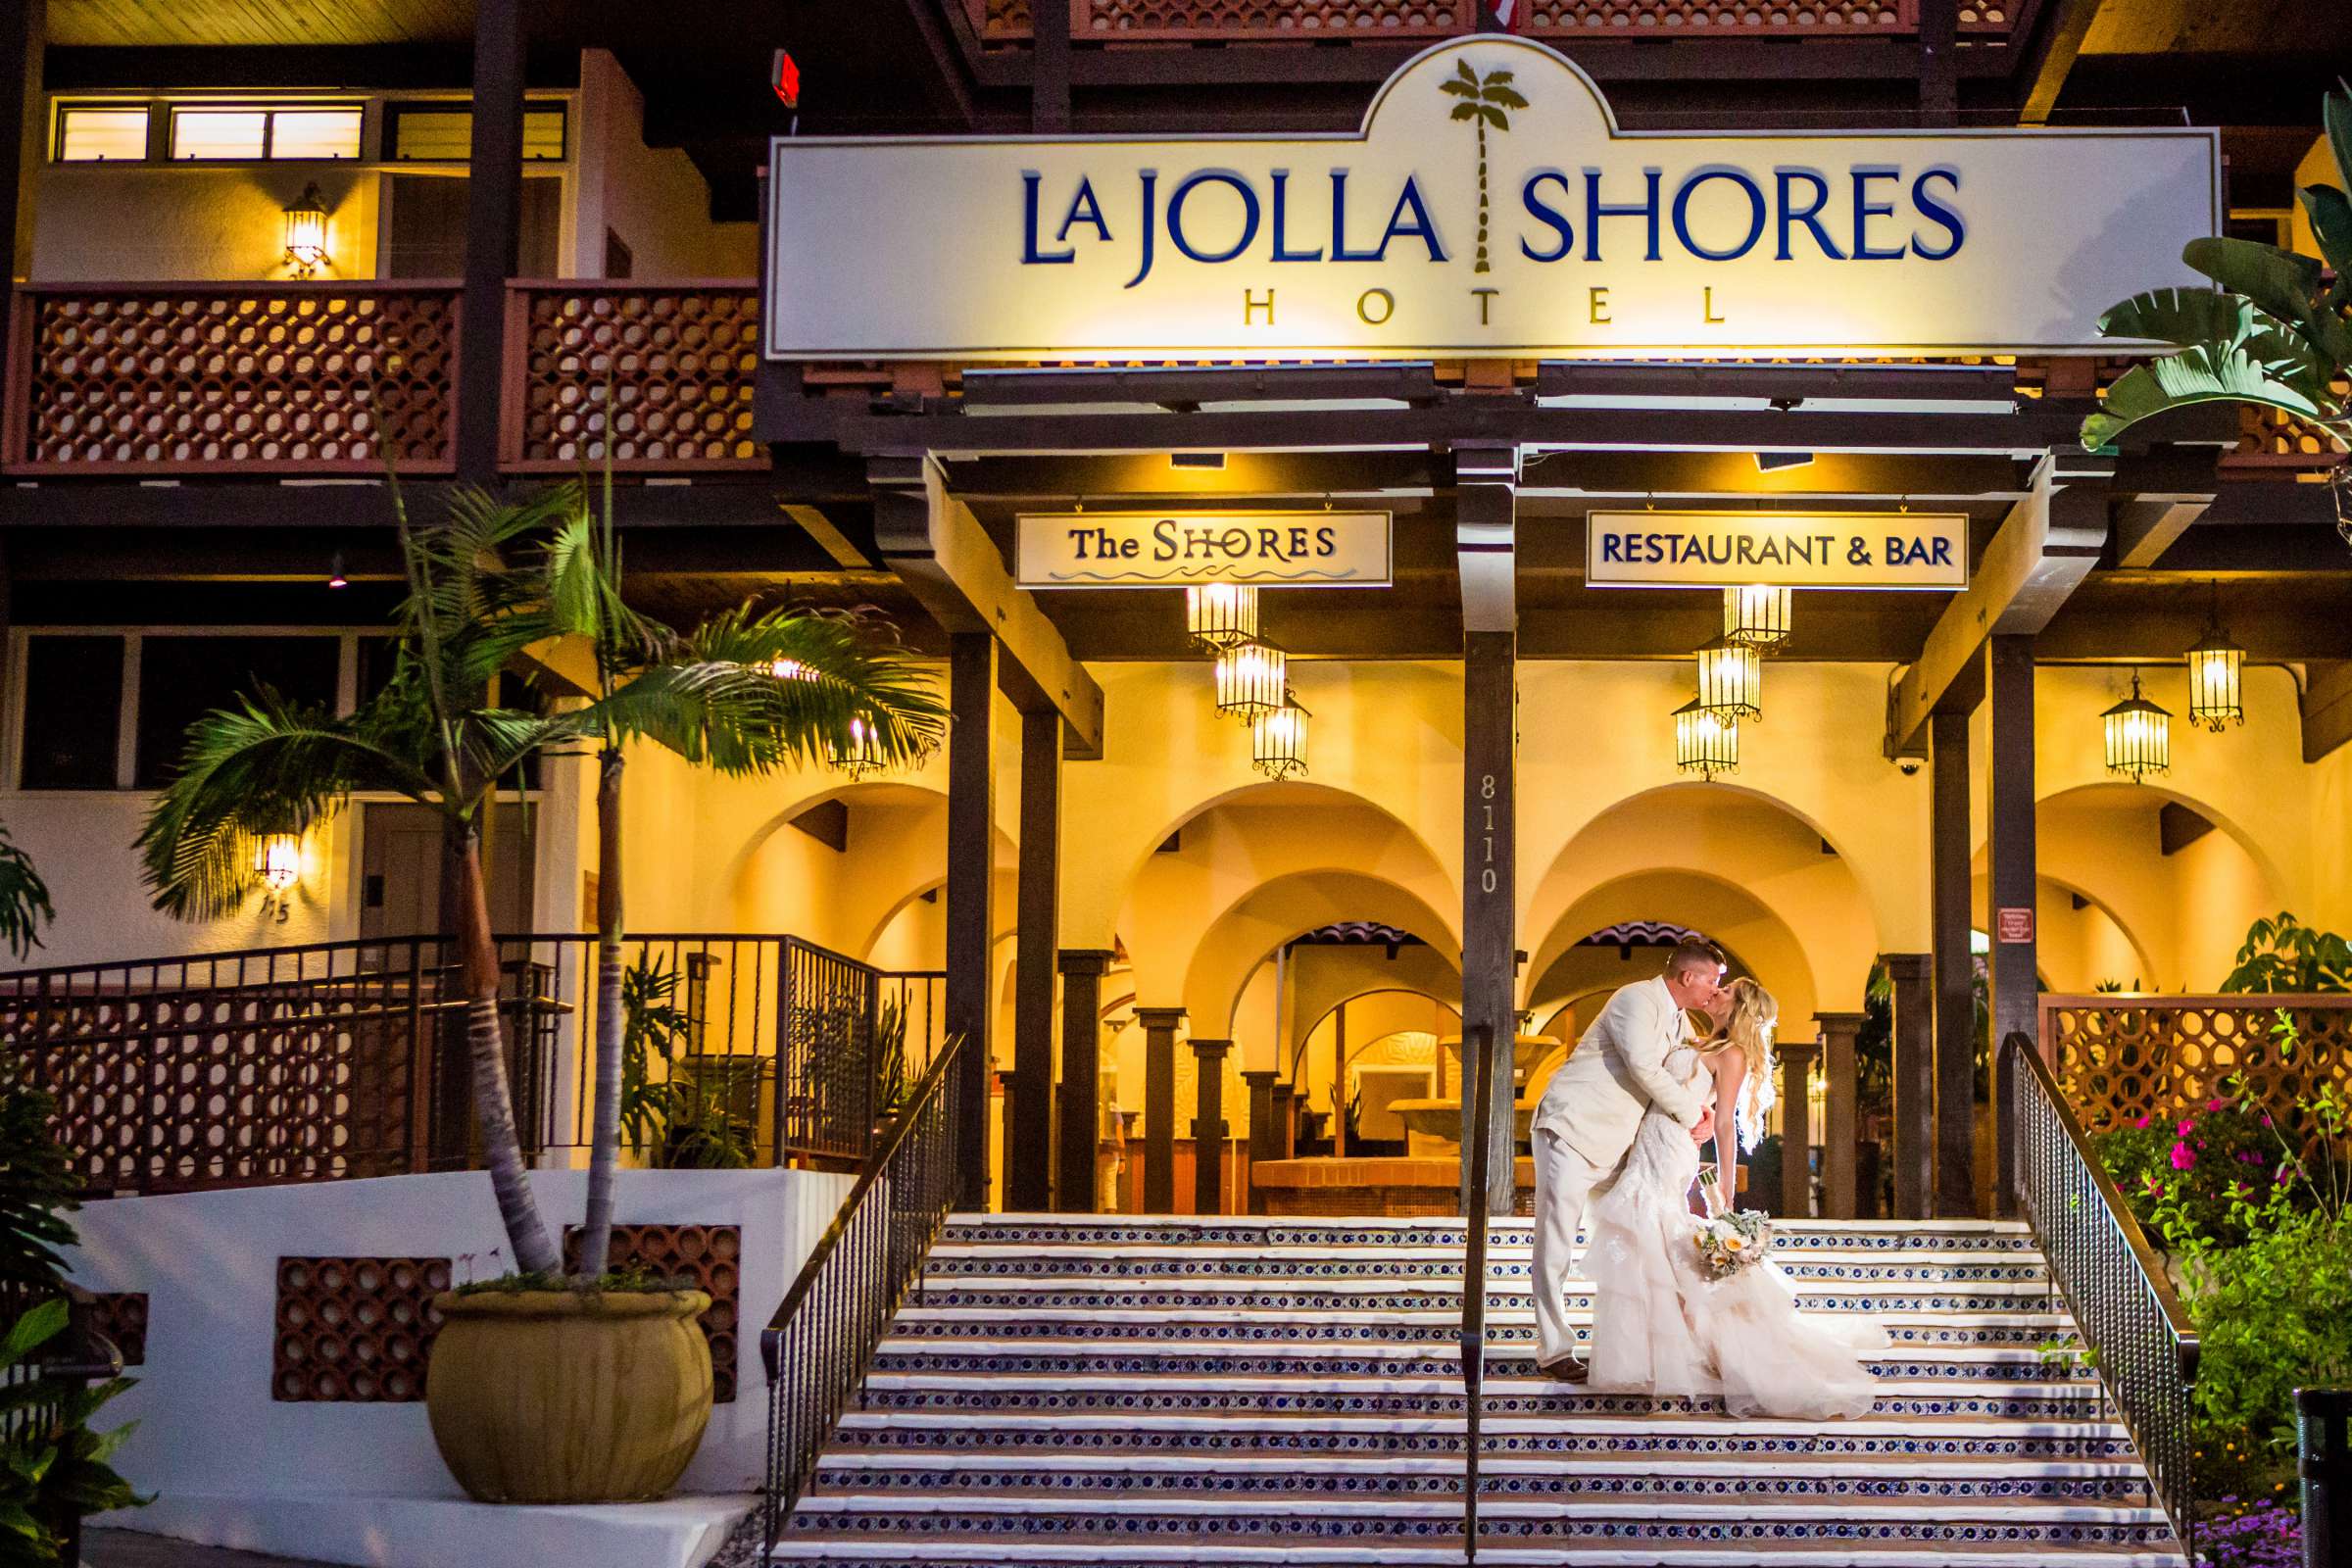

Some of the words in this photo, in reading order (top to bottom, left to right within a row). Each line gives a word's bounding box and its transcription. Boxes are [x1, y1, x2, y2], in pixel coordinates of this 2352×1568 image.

[1020, 169, 1114, 265] LA
[1123, 168, 1450, 289] JOLLA
[1521, 164, 1967, 263] SHORES
[1244, 287, 1726, 326] HOTEL
[1068, 528, 1140, 560] The
[1152, 519, 1337, 564] SHORES
[1602, 533, 1836, 566] RESTAURANT
[1846, 536, 1873, 566] &
[1885, 536, 1954, 566] BAR
[1481, 774, 1497, 894] 8110
